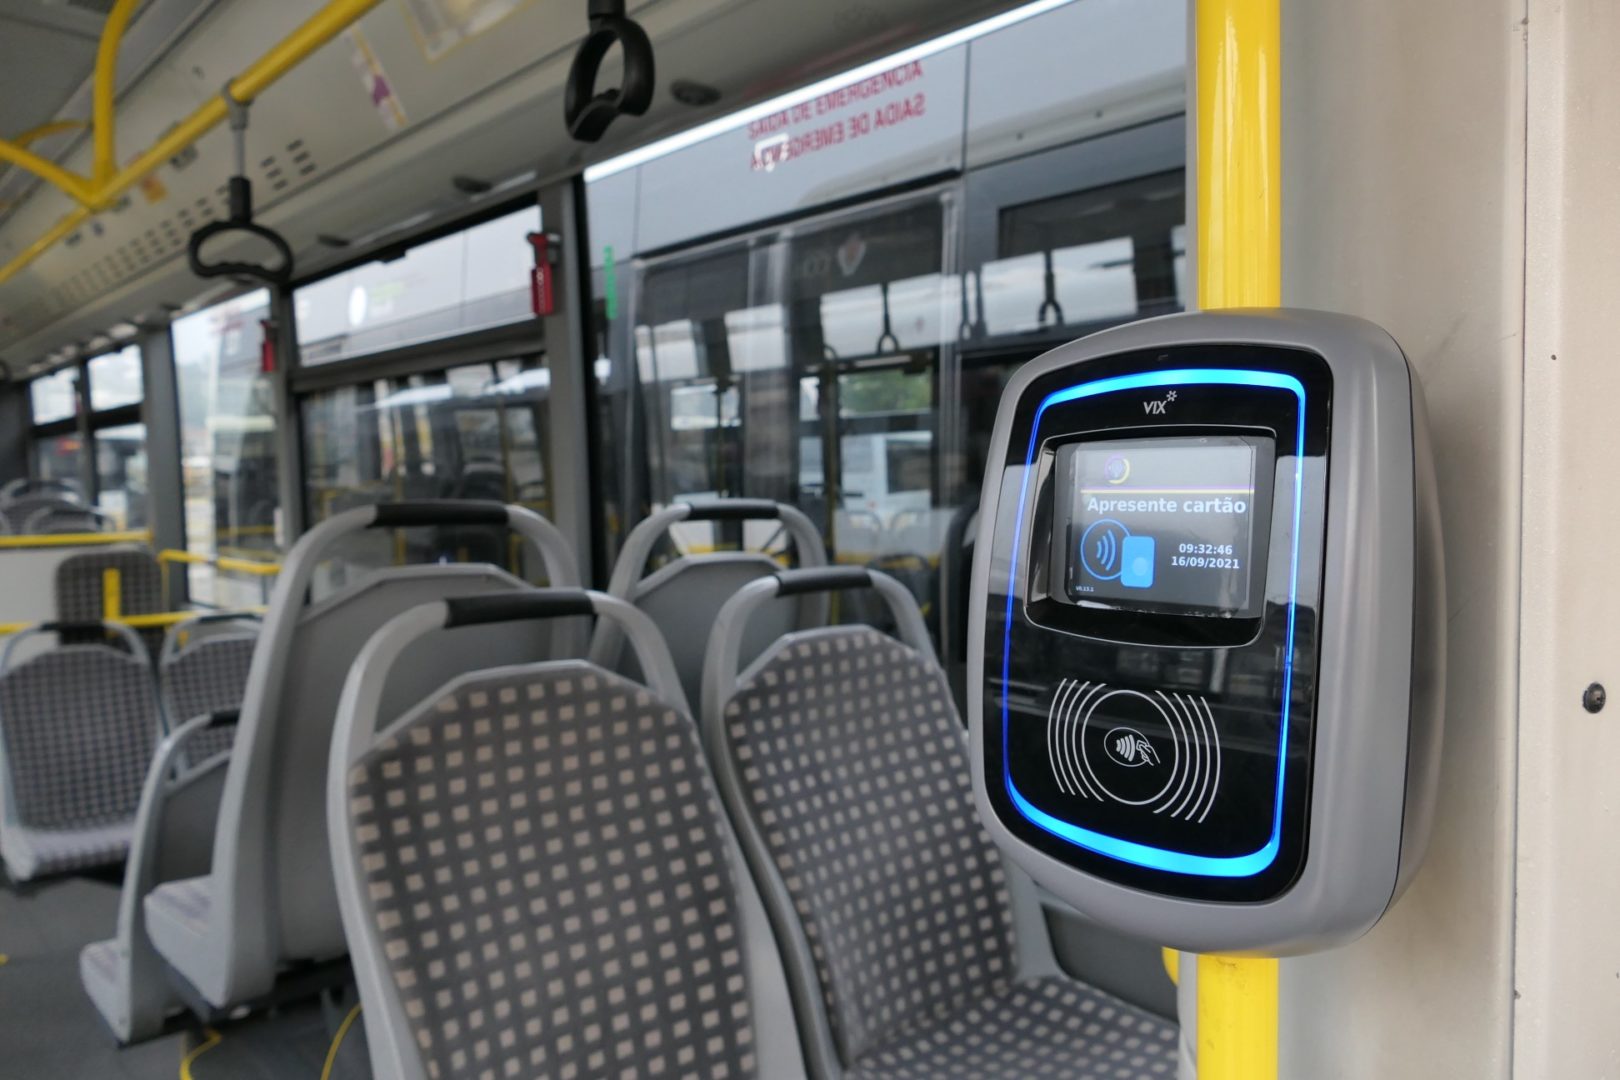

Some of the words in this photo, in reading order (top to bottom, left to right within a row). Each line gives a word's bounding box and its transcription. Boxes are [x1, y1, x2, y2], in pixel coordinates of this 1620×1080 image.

[793, 102, 811, 124] DE
[1143, 400, 1167, 415] VIX
[1087, 498, 1177, 514] Apresente
[1183, 496, 1247, 514] cartão
[1179, 543, 1233, 555] 09:32:46
[1171, 556, 1240, 569] 16/09/2021
